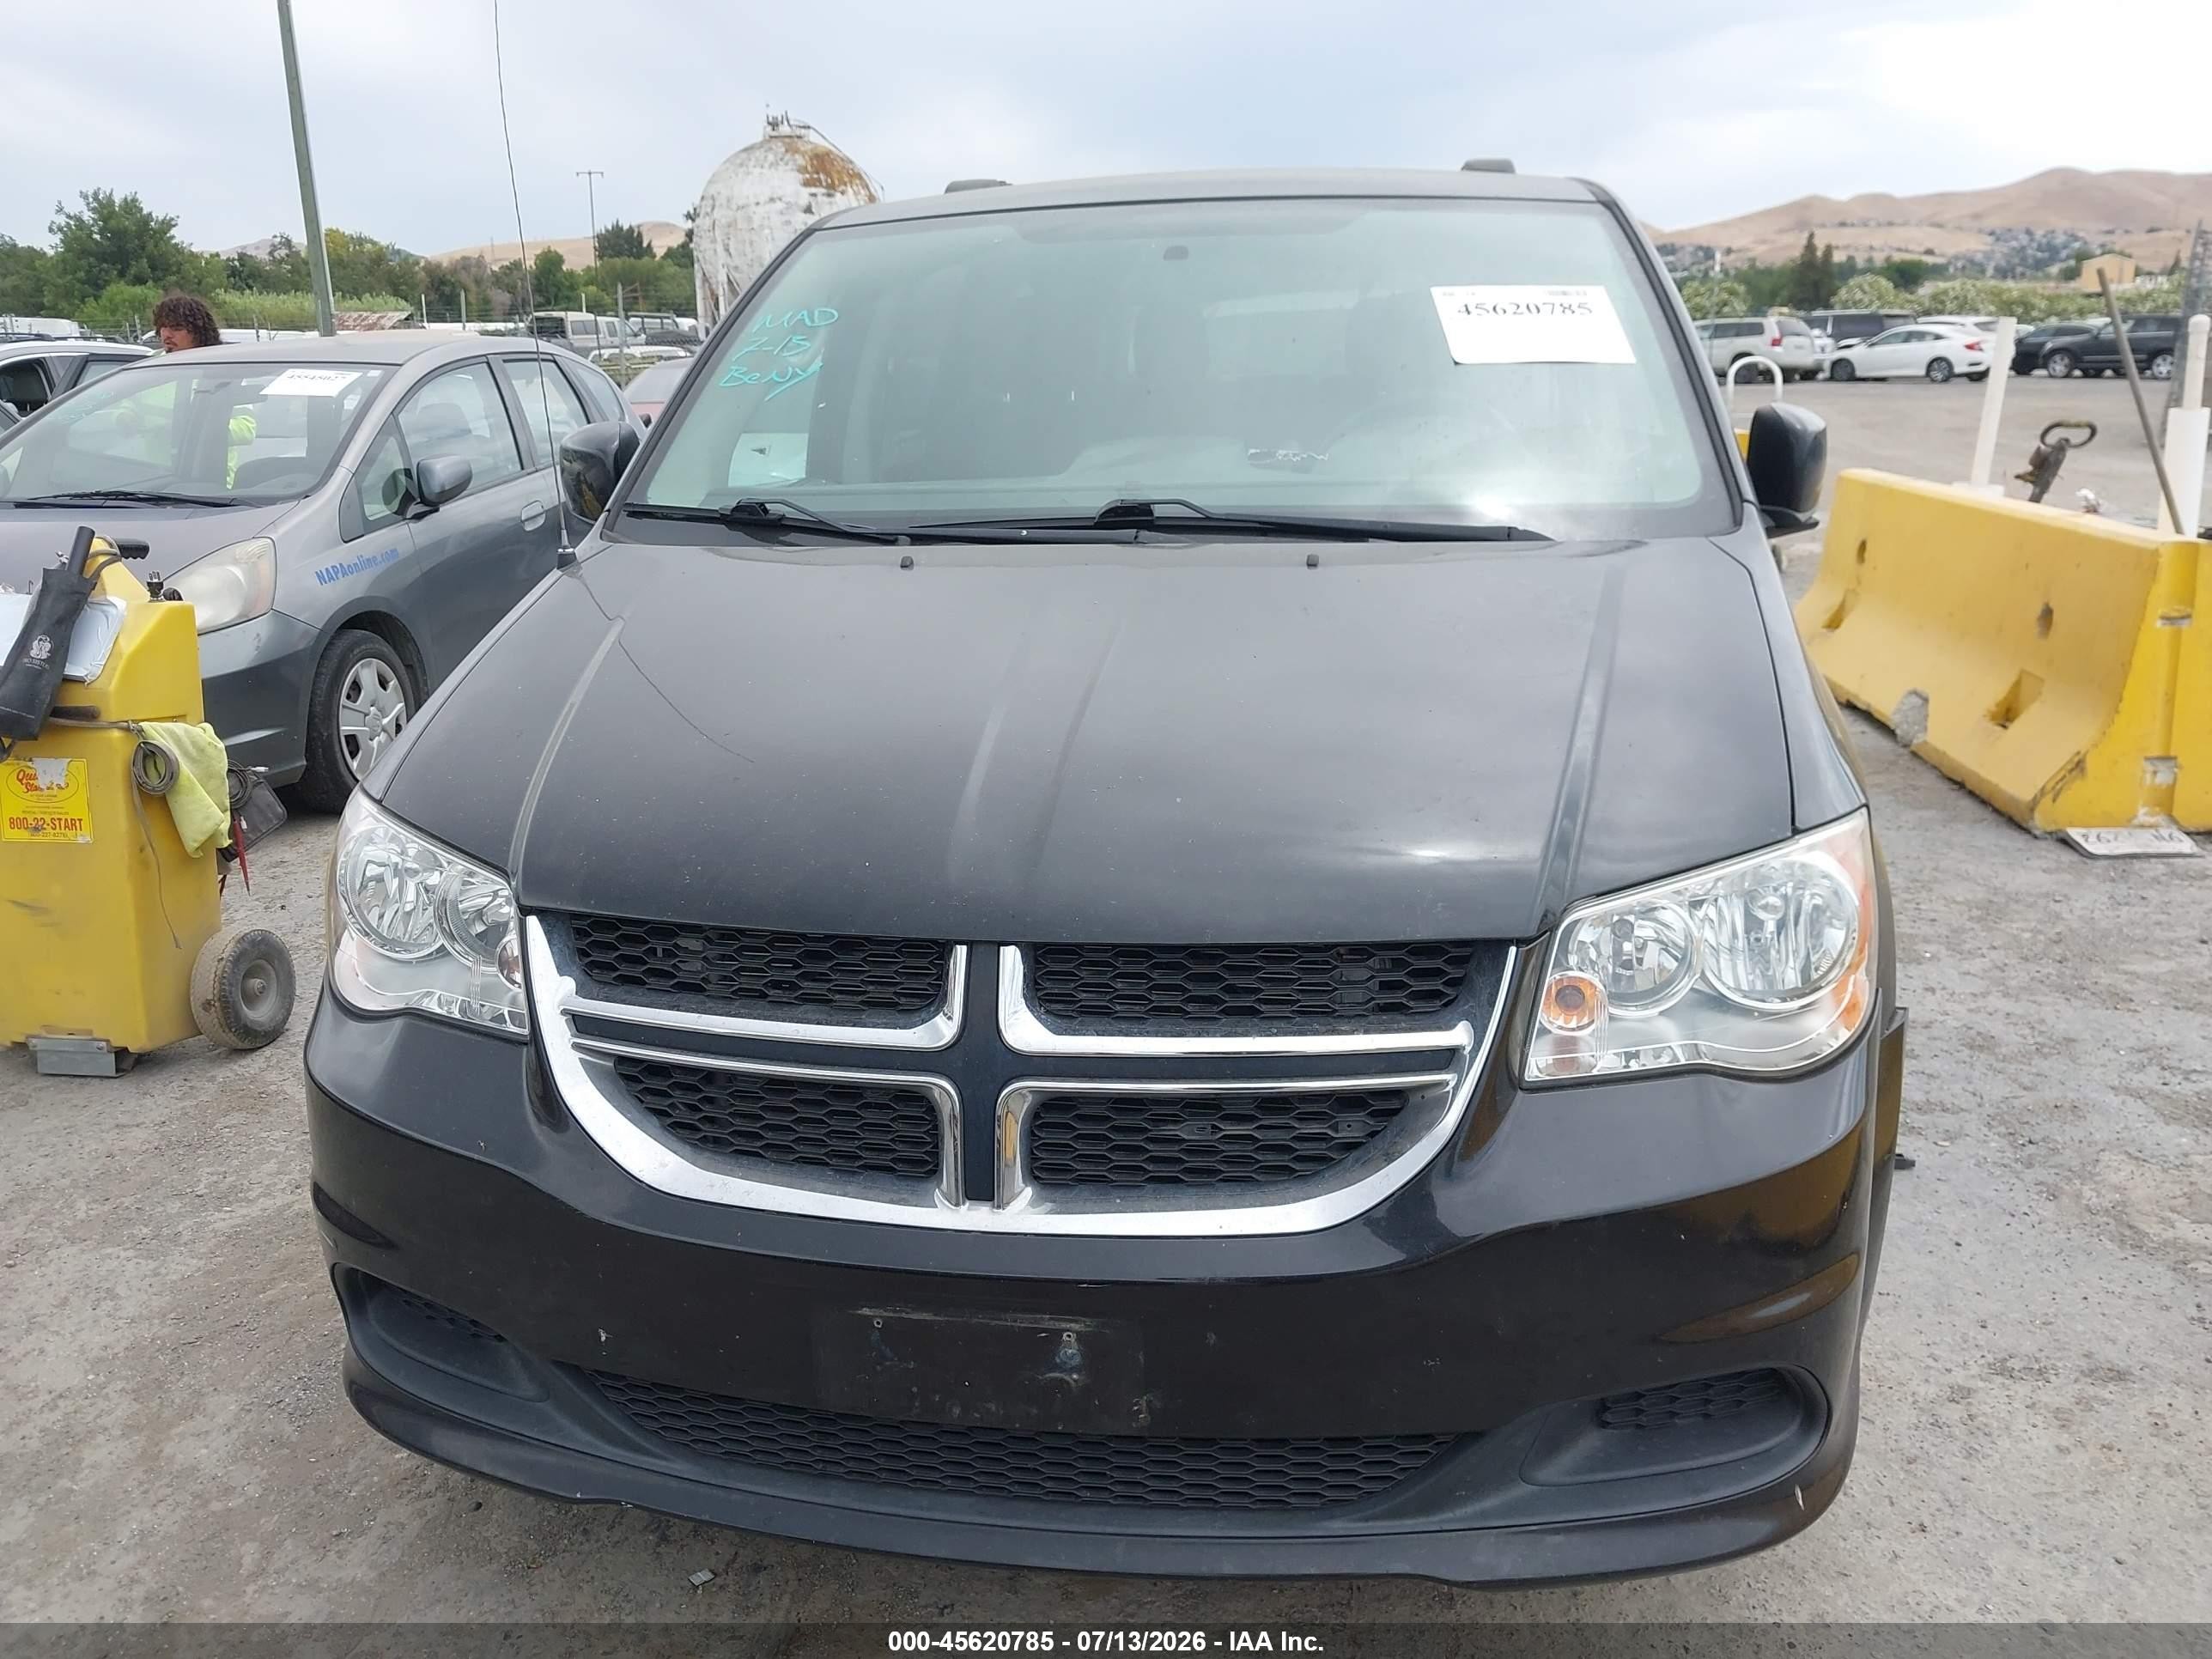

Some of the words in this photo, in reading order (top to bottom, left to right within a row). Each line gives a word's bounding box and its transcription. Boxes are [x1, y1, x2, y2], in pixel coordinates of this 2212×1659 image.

[1457, 302, 1593, 316] 45620785
[314, 547, 399, 586] NAPAonline.com
[9, 817, 83, 831] 800-22-START
